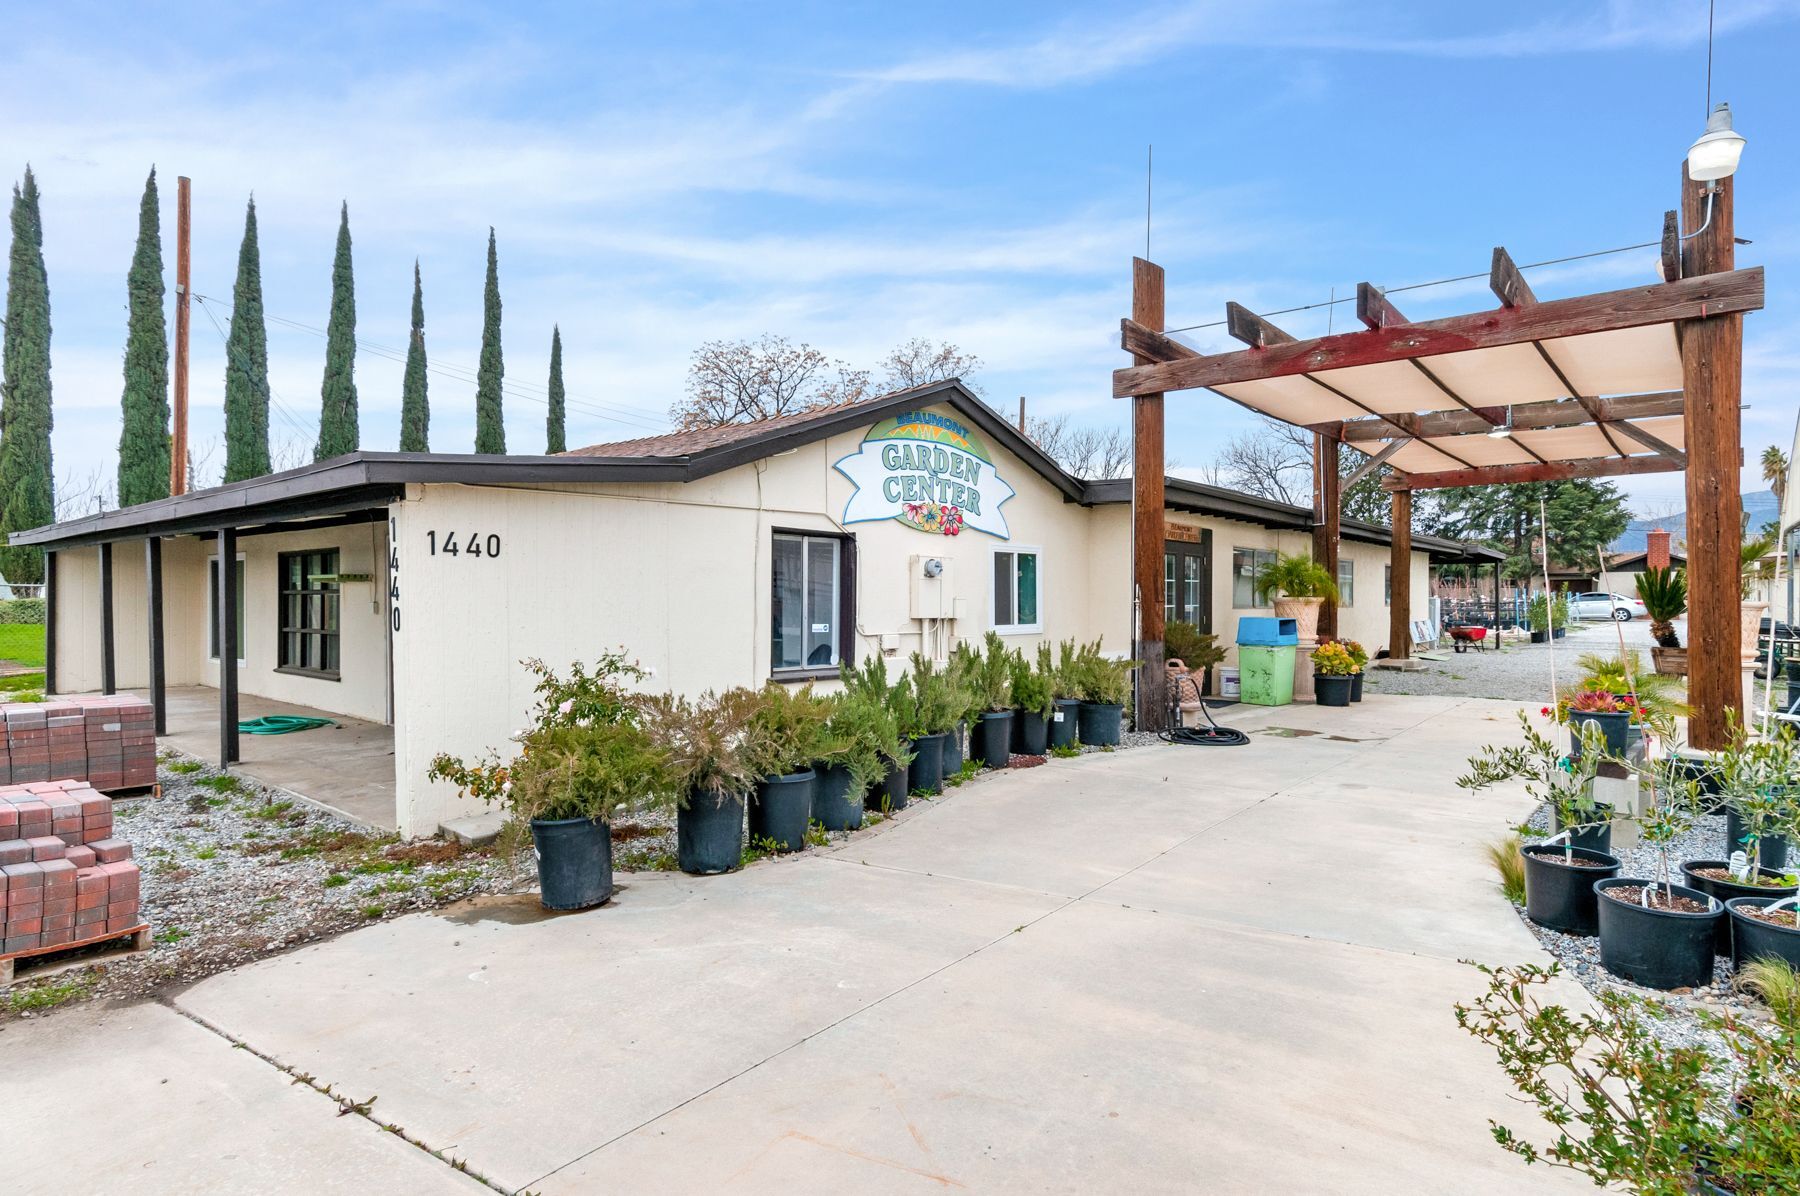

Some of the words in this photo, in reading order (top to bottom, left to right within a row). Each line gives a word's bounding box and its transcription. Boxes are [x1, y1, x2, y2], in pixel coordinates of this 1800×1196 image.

[896, 411, 969, 439] BEAUMONT
[881, 443, 981, 486] GARDEN
[882, 475, 981, 516] CENTER
[427, 530, 501, 558] 1440
[390, 516, 401, 632] 1440
